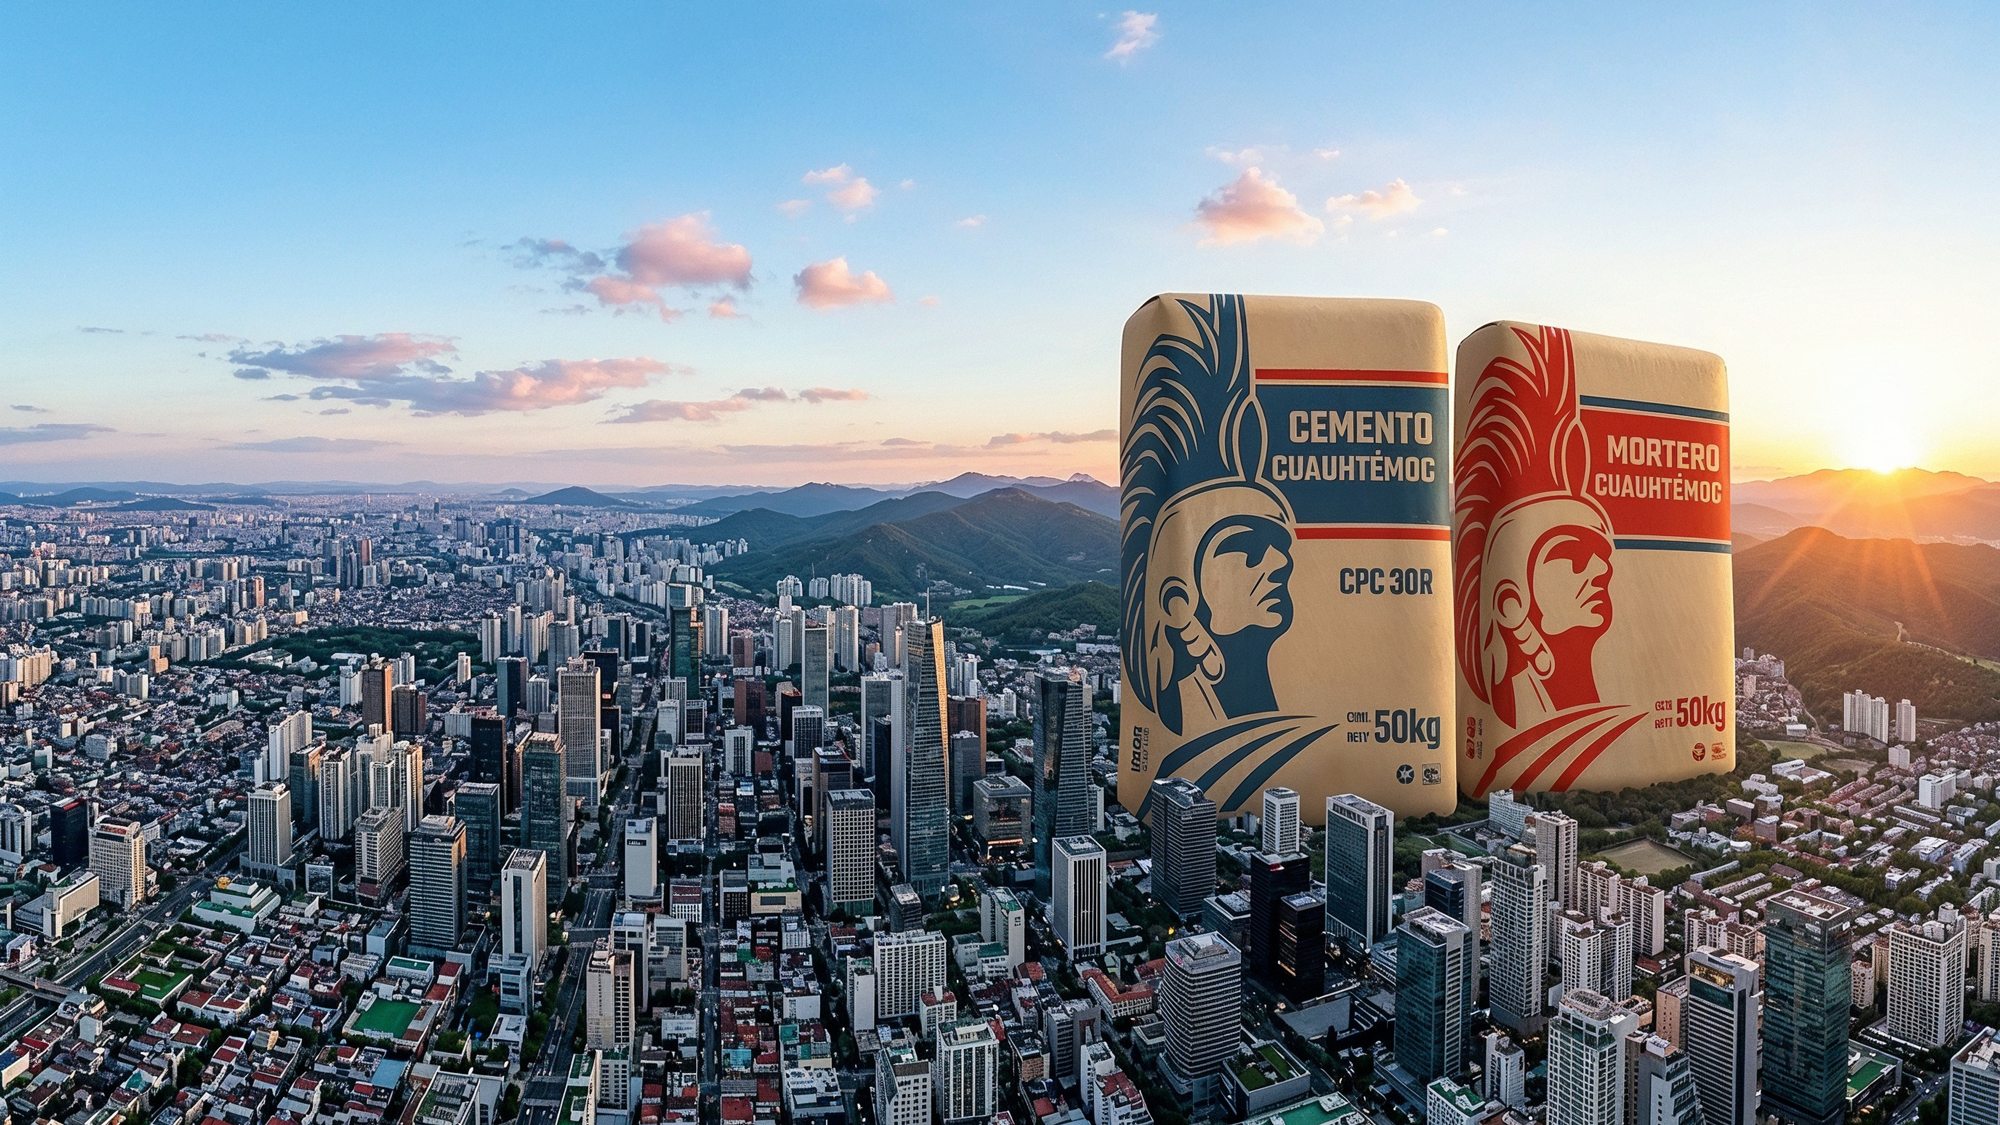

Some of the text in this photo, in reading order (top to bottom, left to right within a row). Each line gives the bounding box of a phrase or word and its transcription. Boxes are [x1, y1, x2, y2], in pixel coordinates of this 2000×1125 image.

[1289, 410, 1433, 445] CEMENTO
[1271, 449, 1436, 483] CUAUHTÉMOC
[1607, 434, 1720, 473] MORTERO
[1594, 472, 1722, 505] CUAUHTÉMOC
[1339, 567, 1433, 595] CPC 30R
[1374, 707, 1441, 750] 50kg
[1676, 695, 1726, 732] 50kg
